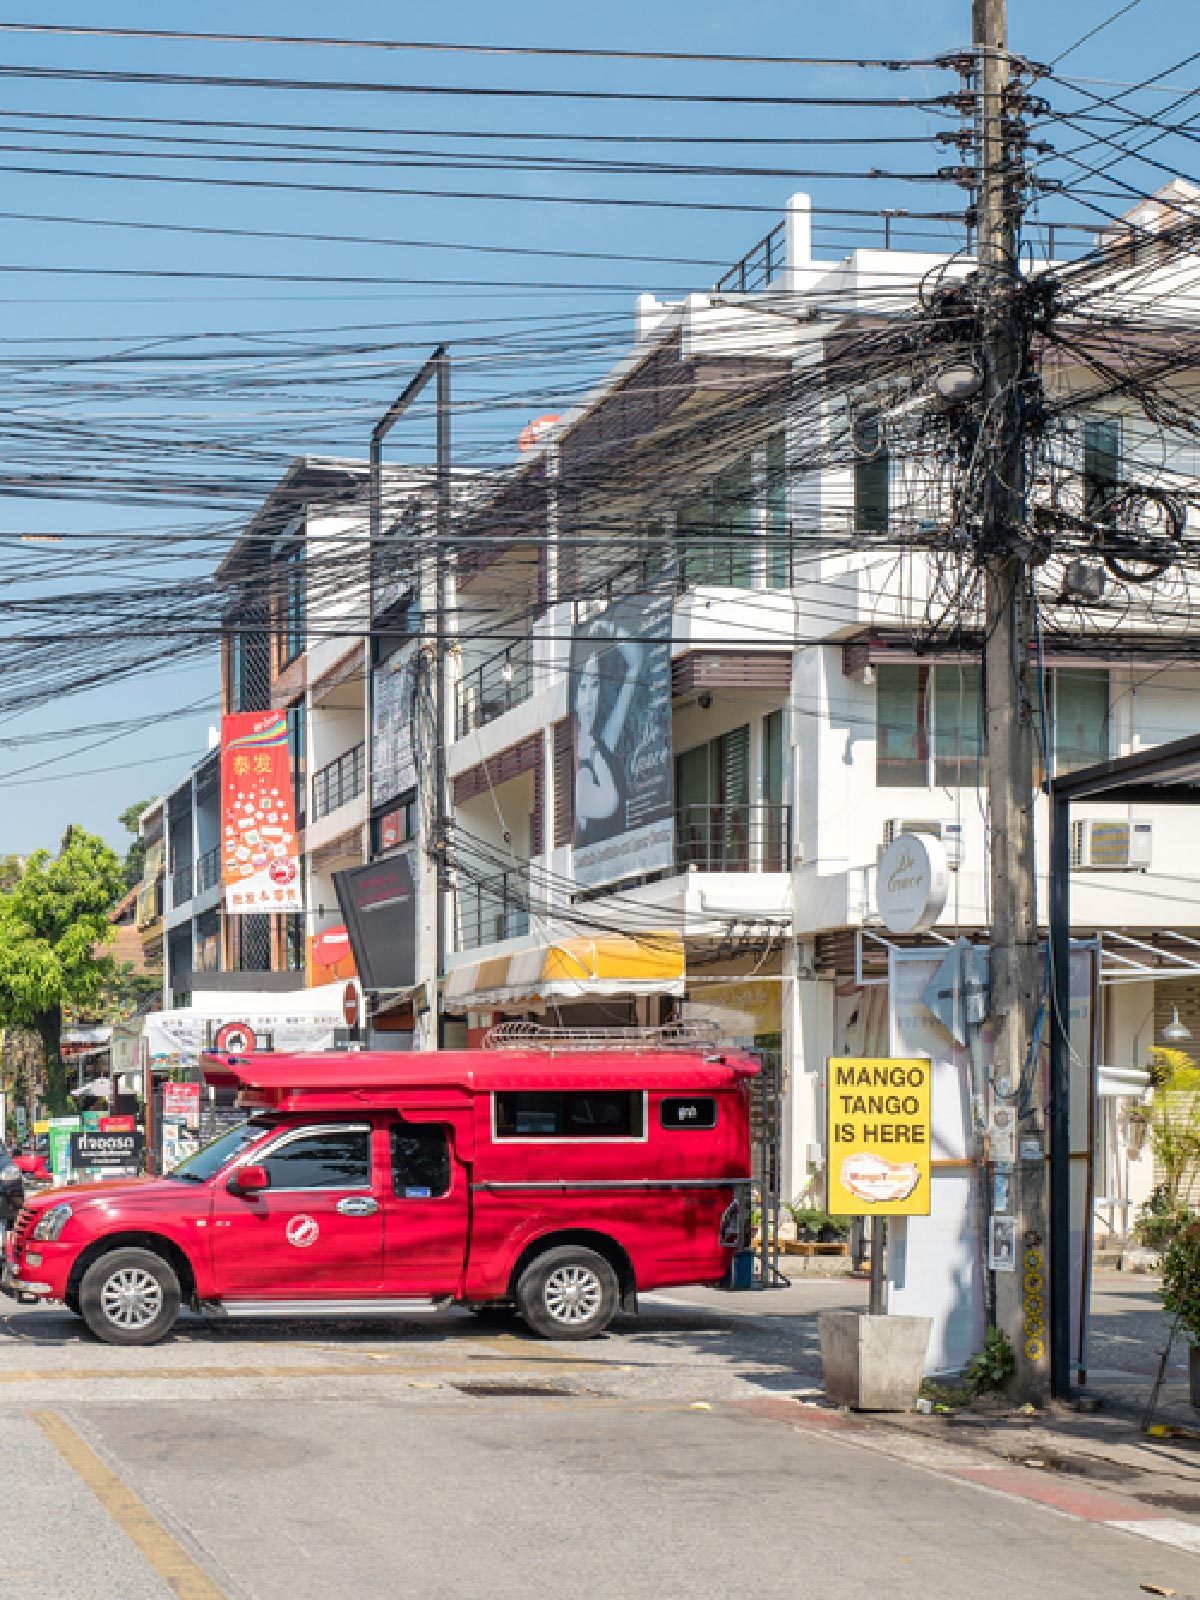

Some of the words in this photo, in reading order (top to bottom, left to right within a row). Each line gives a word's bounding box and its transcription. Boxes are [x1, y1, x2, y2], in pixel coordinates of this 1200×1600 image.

[835, 1066, 925, 1087] MANGO
[839, 1095, 920, 1115] TANGO
[834, 1123, 856, 1143] IS
[863, 1124, 925, 1143] HERE
